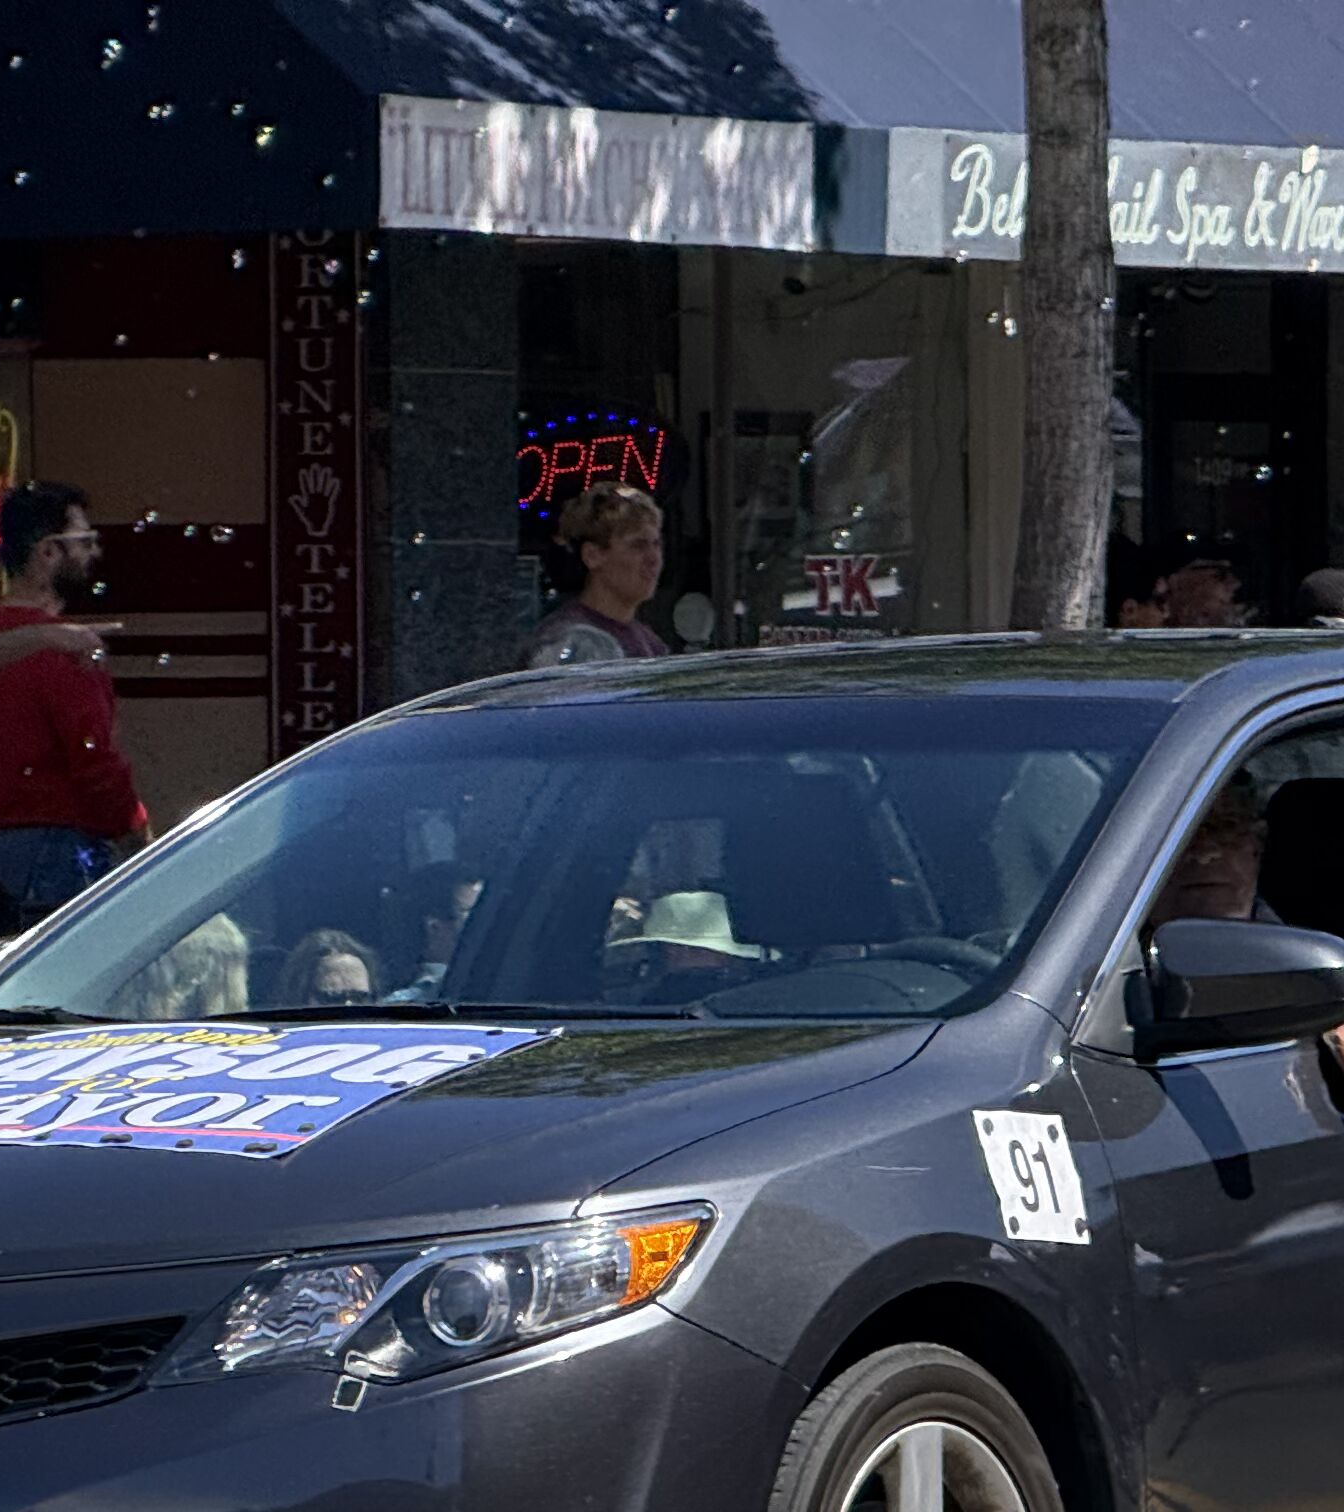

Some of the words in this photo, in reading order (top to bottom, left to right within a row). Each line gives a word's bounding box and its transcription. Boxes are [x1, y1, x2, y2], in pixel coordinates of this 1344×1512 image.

[1167, 166, 1235, 264] Spa
[1245, 161, 1277, 248] &
[515, 430, 666, 504] OPEN
[1008, 1139, 1062, 1214] 91
